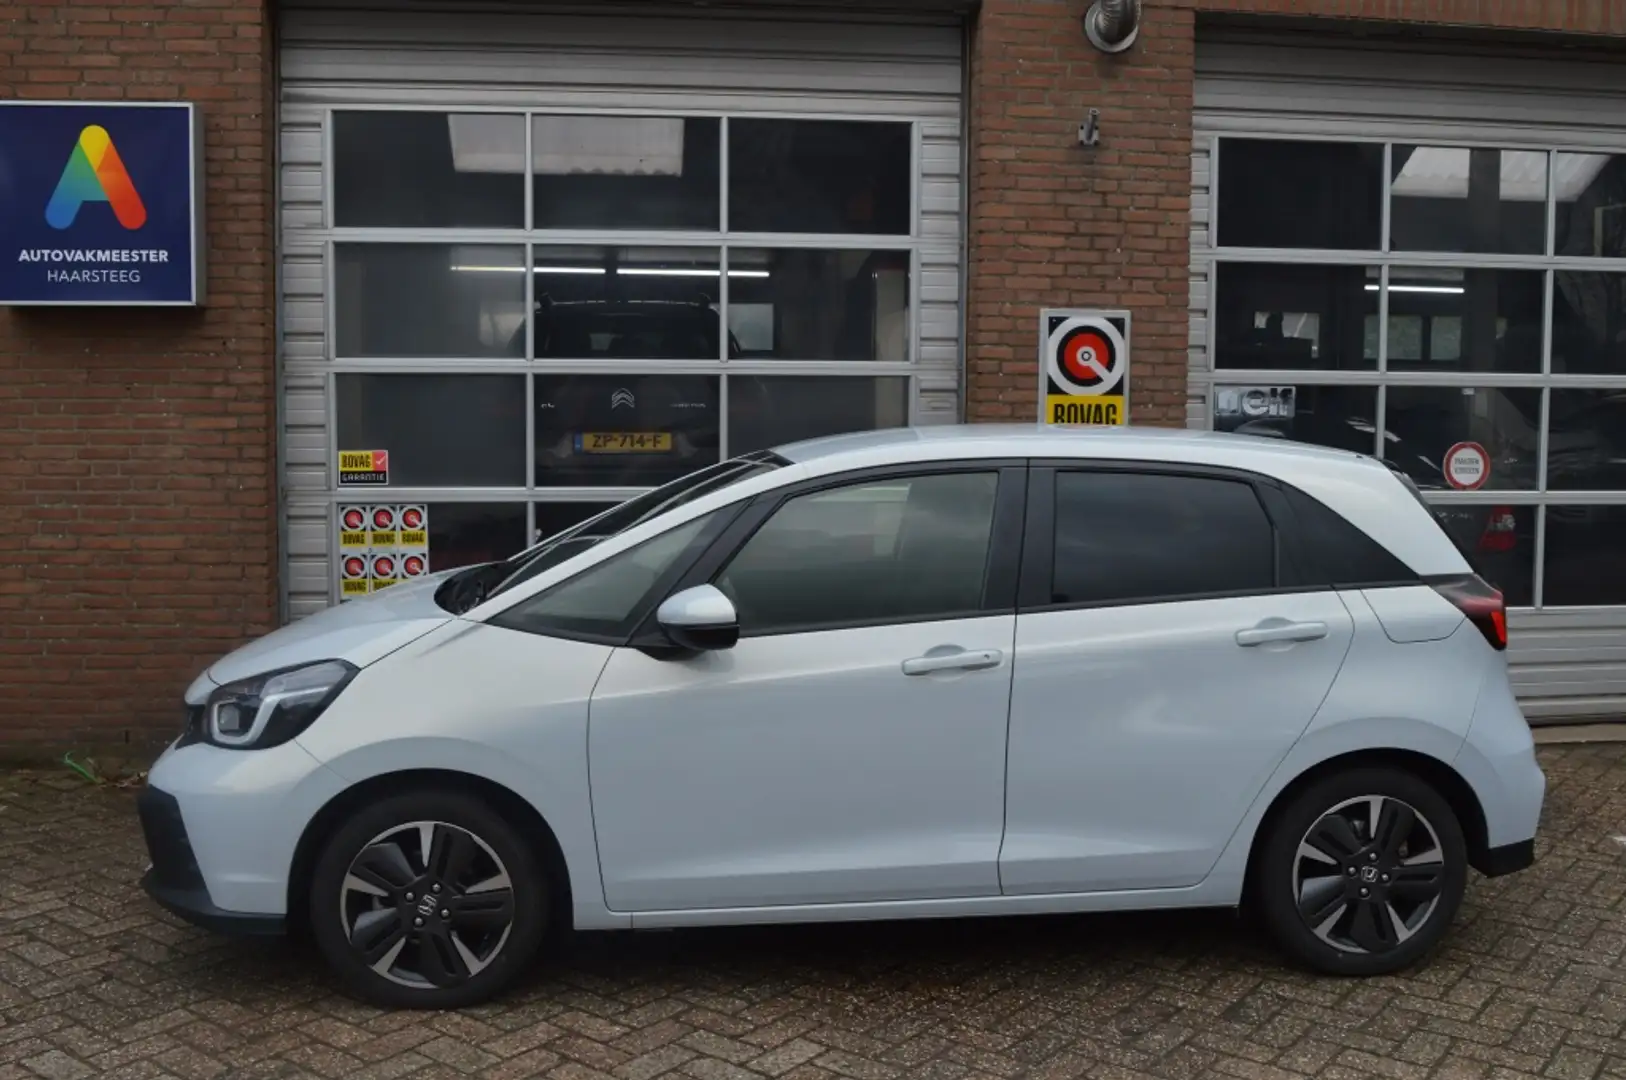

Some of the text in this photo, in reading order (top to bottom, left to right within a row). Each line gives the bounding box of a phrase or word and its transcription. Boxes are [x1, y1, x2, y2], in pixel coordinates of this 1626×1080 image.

[45, 125, 147, 230] A
[18, 249, 169, 262] AUTOVAKMEESTER
[47, 270, 141, 283] HAARSTEEG
[1054, 403, 1117, 425] BOVAG
[592, 434, 662, 448] ZP-714-F
[342, 454, 371, 468] BOVAG
[342, 473, 385, 481] GARANTIE
[343, 533, 365, 544] BOVAG
[402, 532, 424, 543] BOVAG
